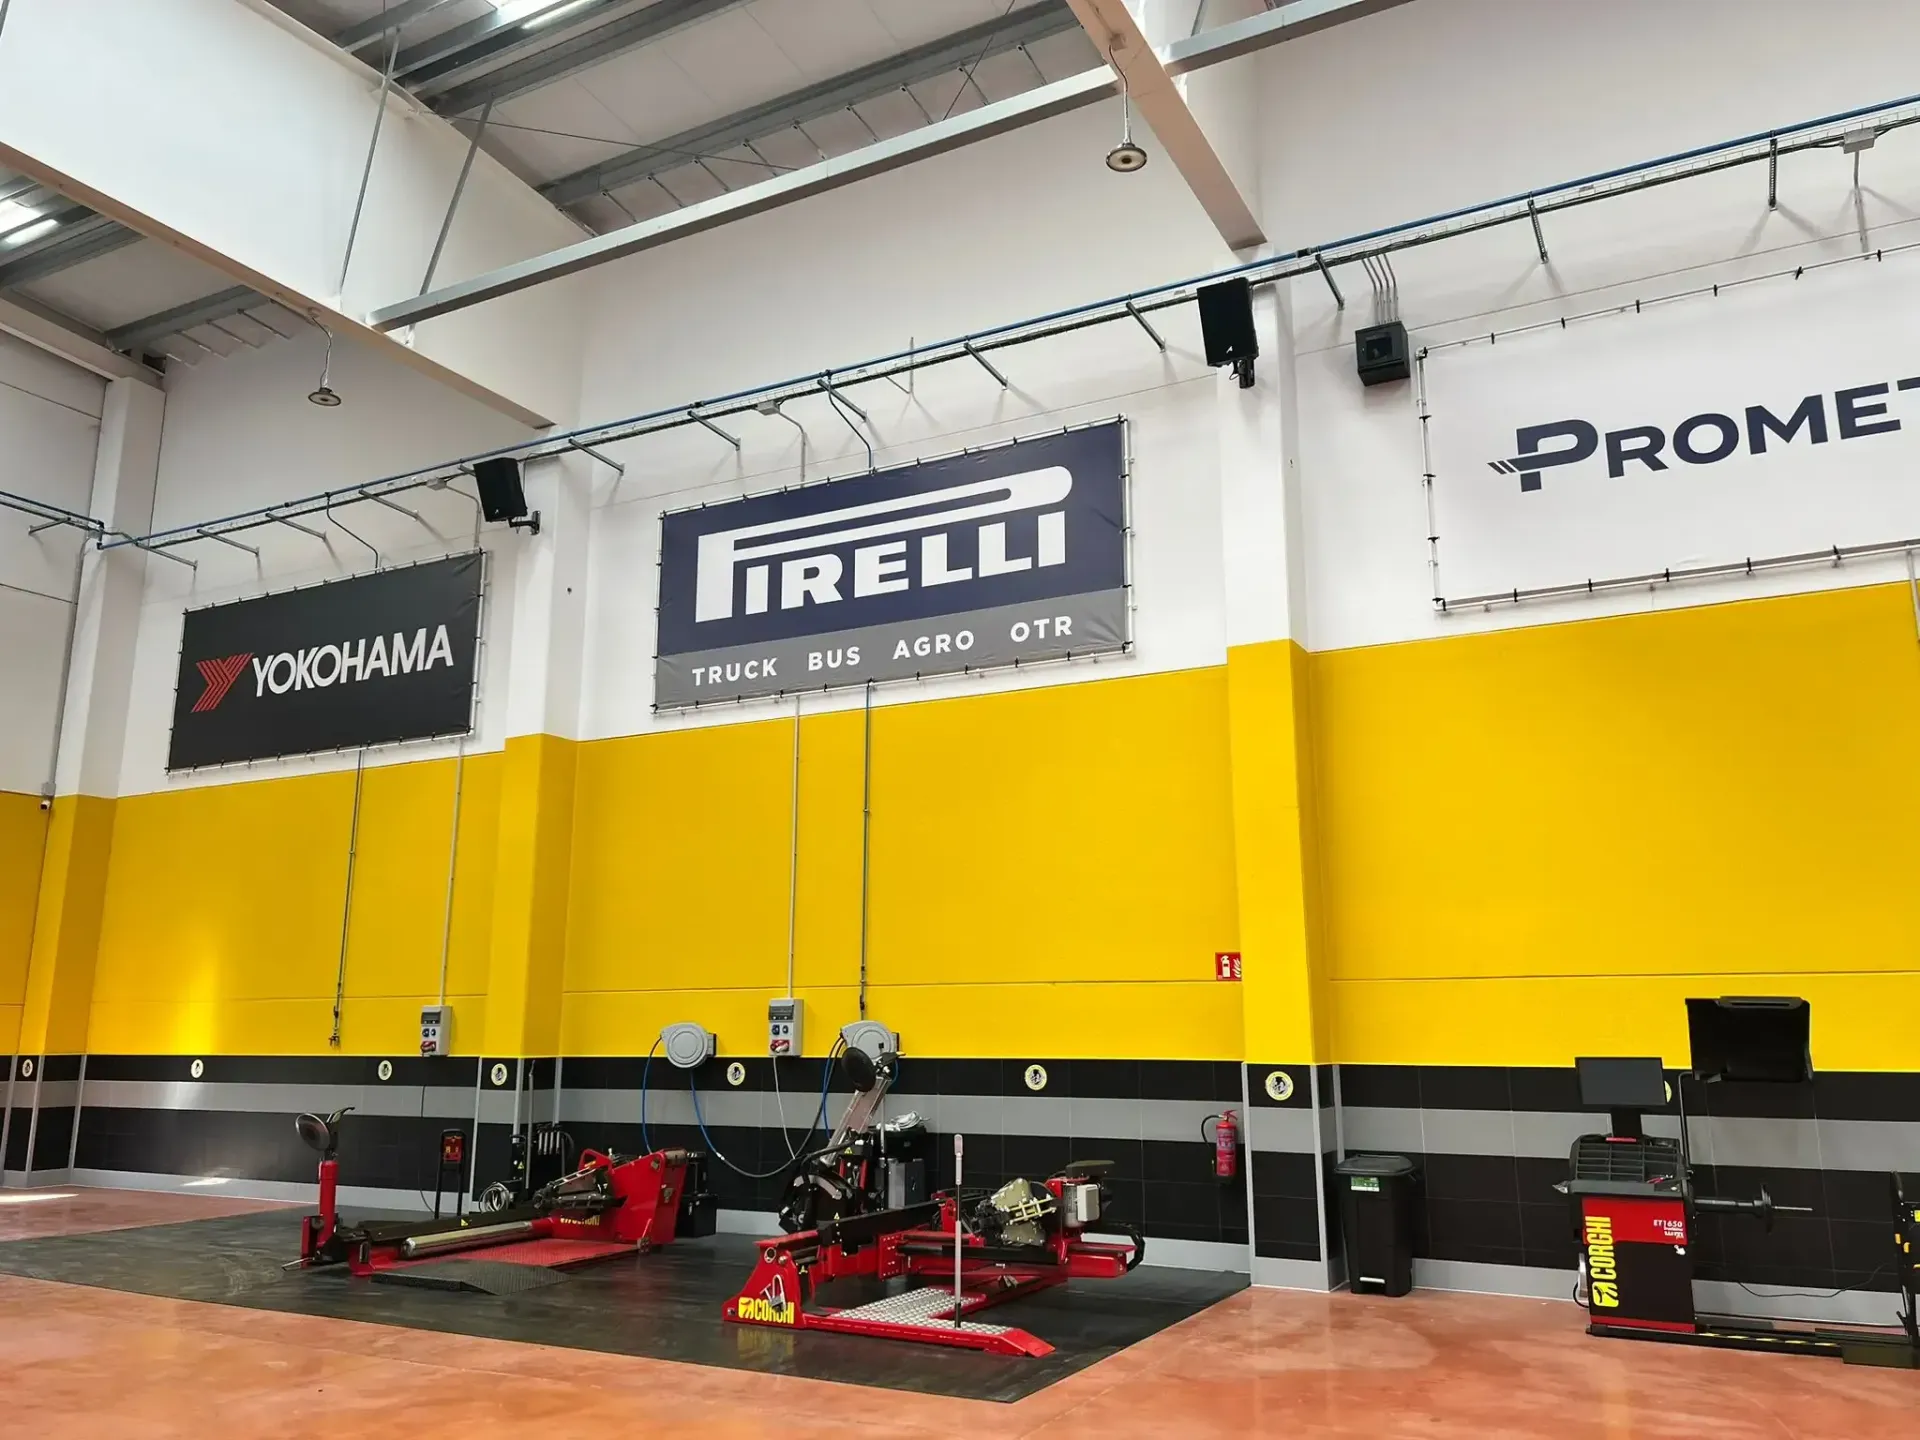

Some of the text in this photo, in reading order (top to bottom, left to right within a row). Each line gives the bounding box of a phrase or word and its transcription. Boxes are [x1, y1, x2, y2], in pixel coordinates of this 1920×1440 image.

[695, 465, 1073, 623] PIRELLI
[252, 624, 454, 697] YOKOHAMA
[692, 615, 1073, 687] TRUCK BUS AGRO OTR
[1585, 1216, 1617, 1280] CORGHI
